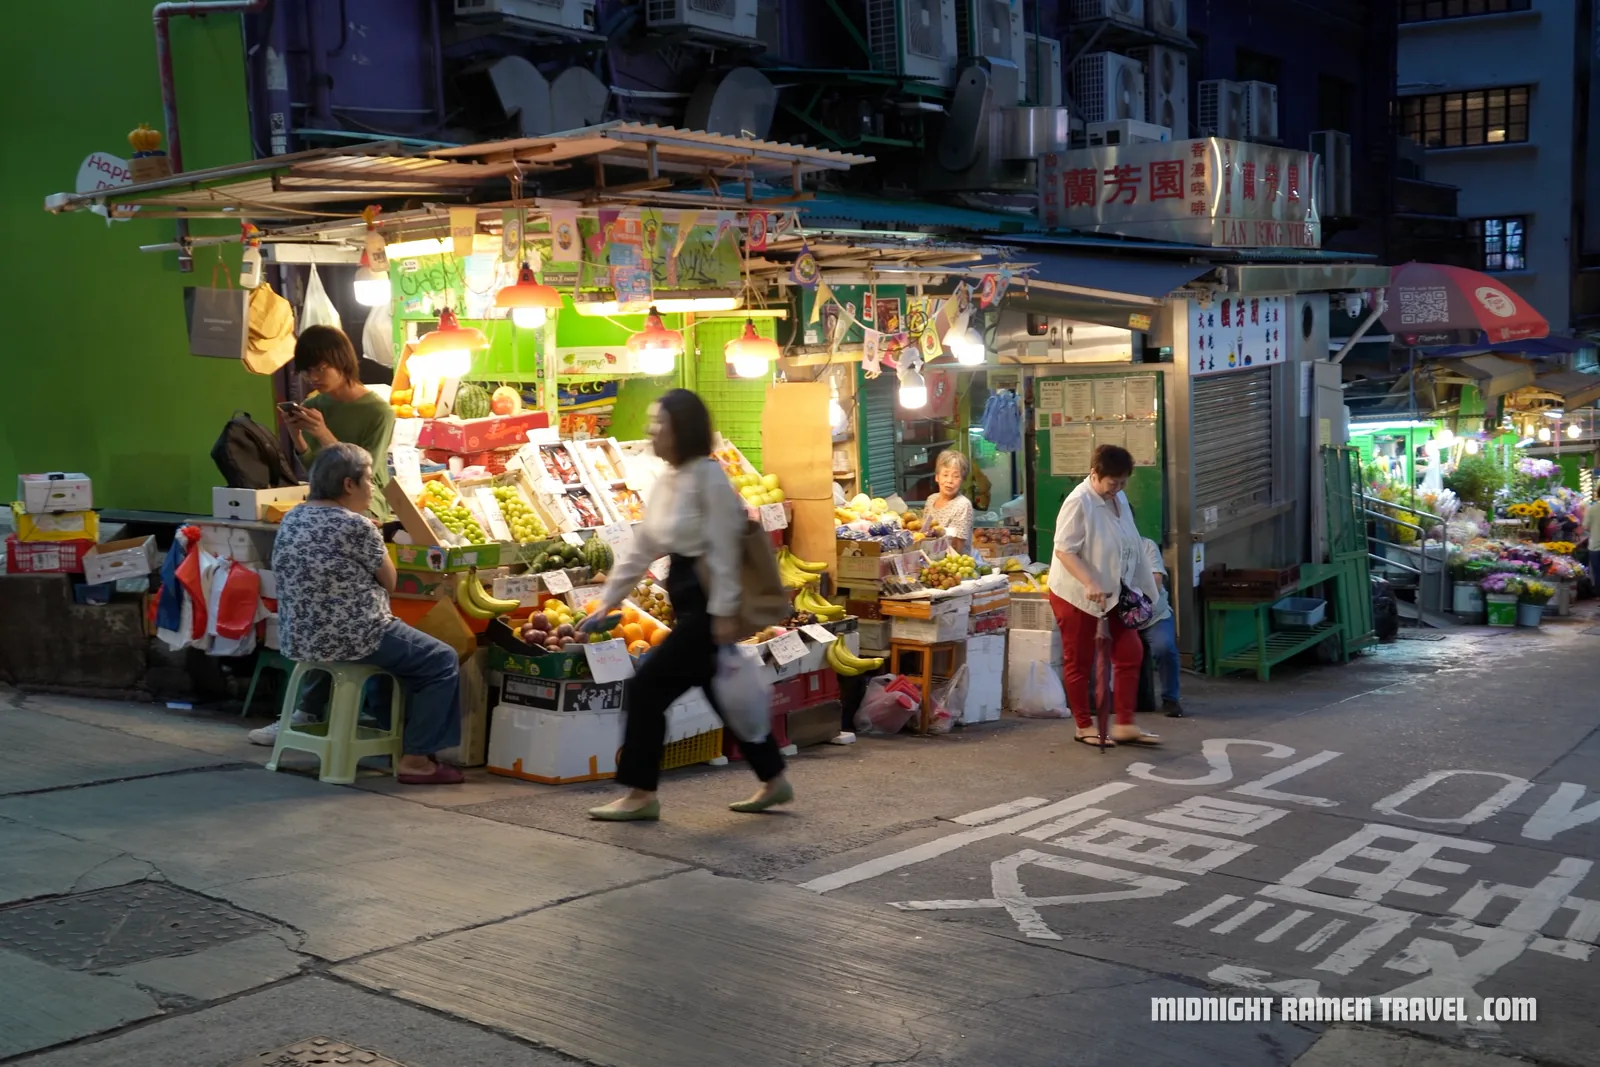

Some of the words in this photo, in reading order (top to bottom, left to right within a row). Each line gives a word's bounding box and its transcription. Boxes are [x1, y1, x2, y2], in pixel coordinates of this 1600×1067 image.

[88, 154, 132, 182] Happ
[1063, 159, 1185, 209] 蘭芳園
[1242, 160, 1300, 204] 蘭芳園
[1221, 220, 1247, 245] LAN
